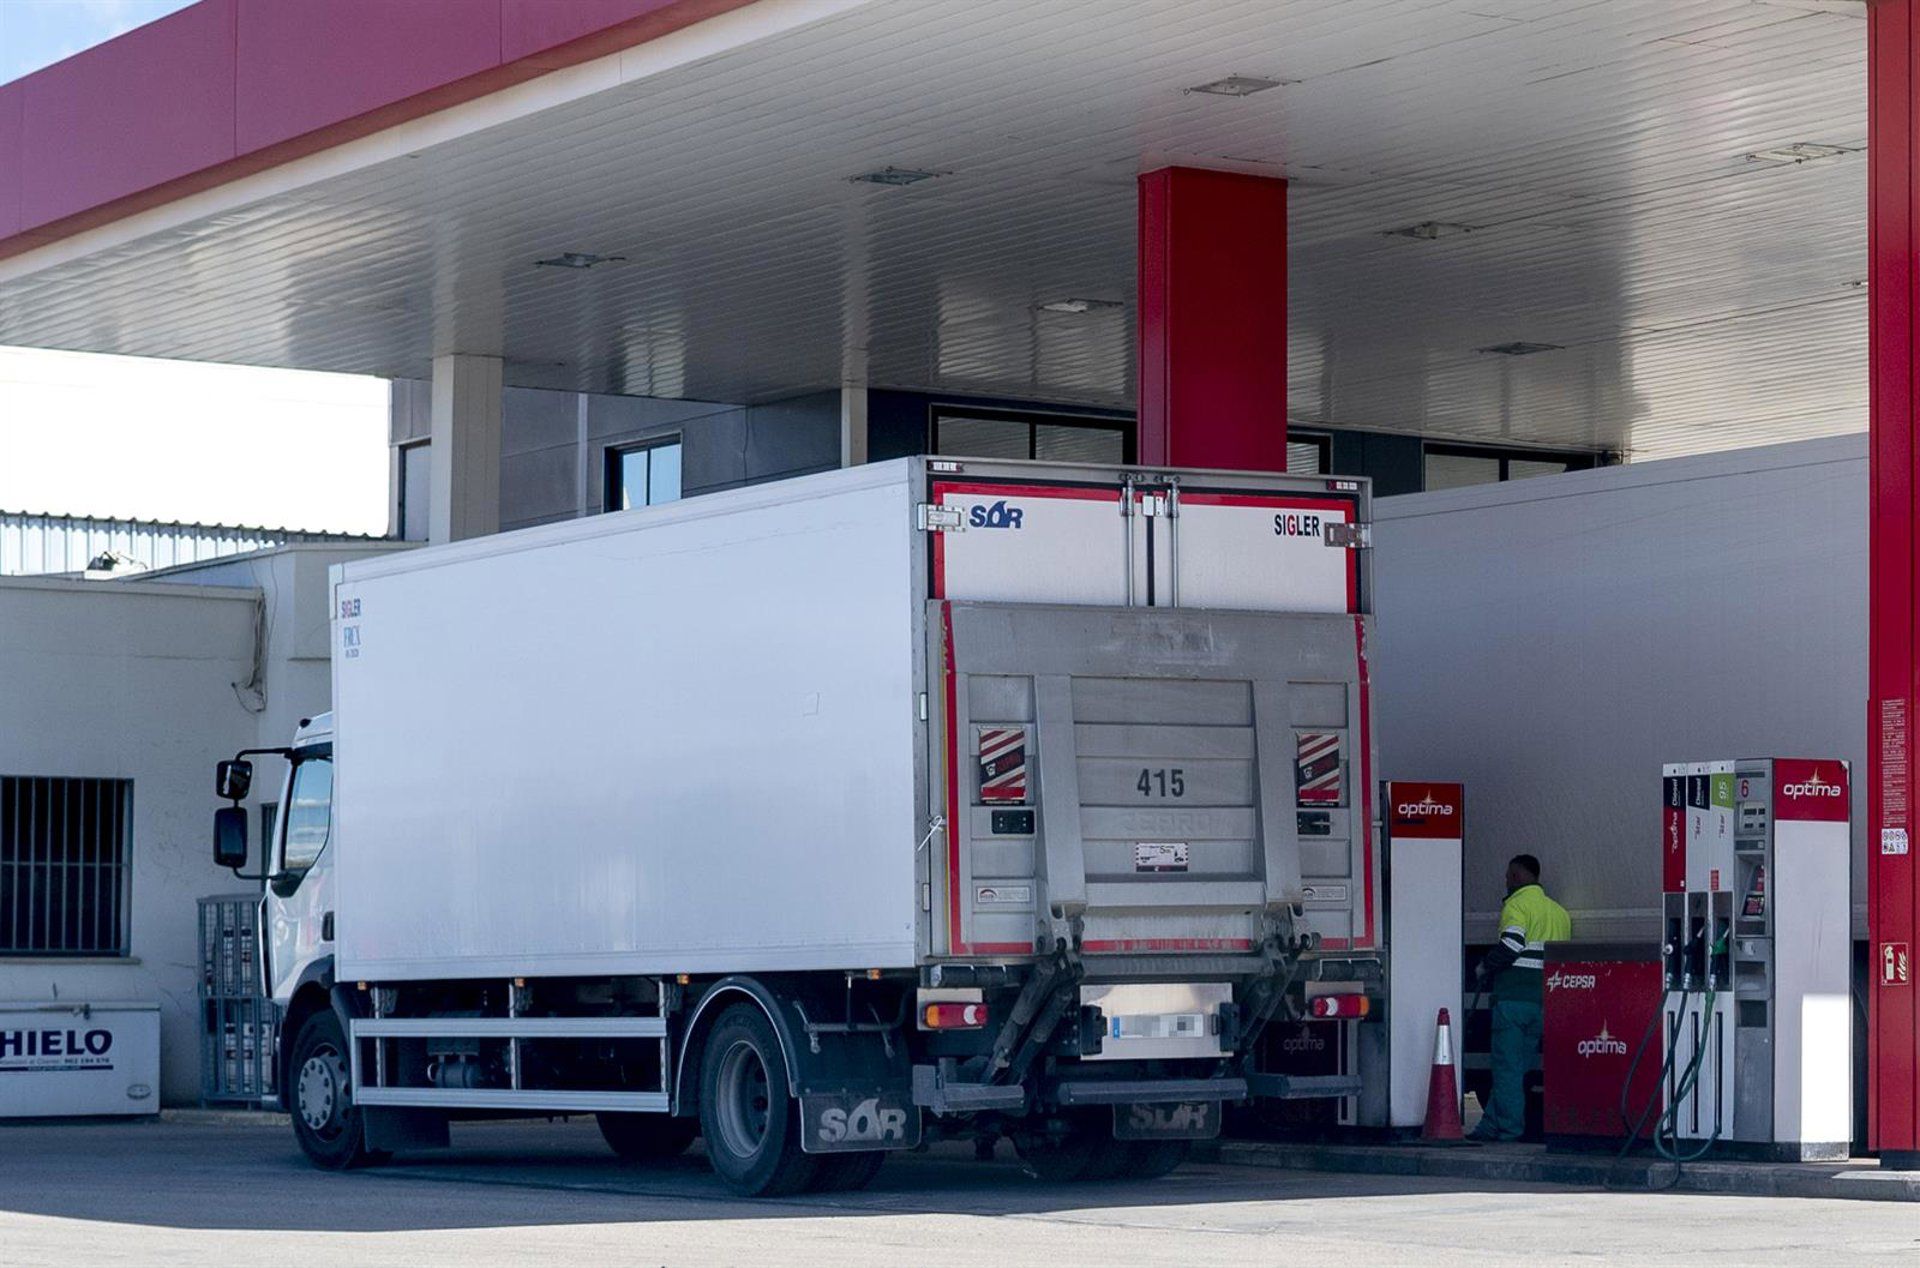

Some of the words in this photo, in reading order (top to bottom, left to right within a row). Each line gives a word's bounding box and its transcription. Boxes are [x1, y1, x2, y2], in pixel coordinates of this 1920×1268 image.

[1274, 514, 1320, 537] SIGLER
[1137, 768, 1185, 797] 415
[1741, 780, 1750, 798] 6
[1783, 782, 1842, 801] optima
[1398, 802, 1454, 819] optima
[1562, 975, 1596, 989] CEPSA
[0, 1029, 113, 1057] HIELO
[1577, 1038, 1627, 1059] optima
[818, 1098, 907, 1142] SOR
